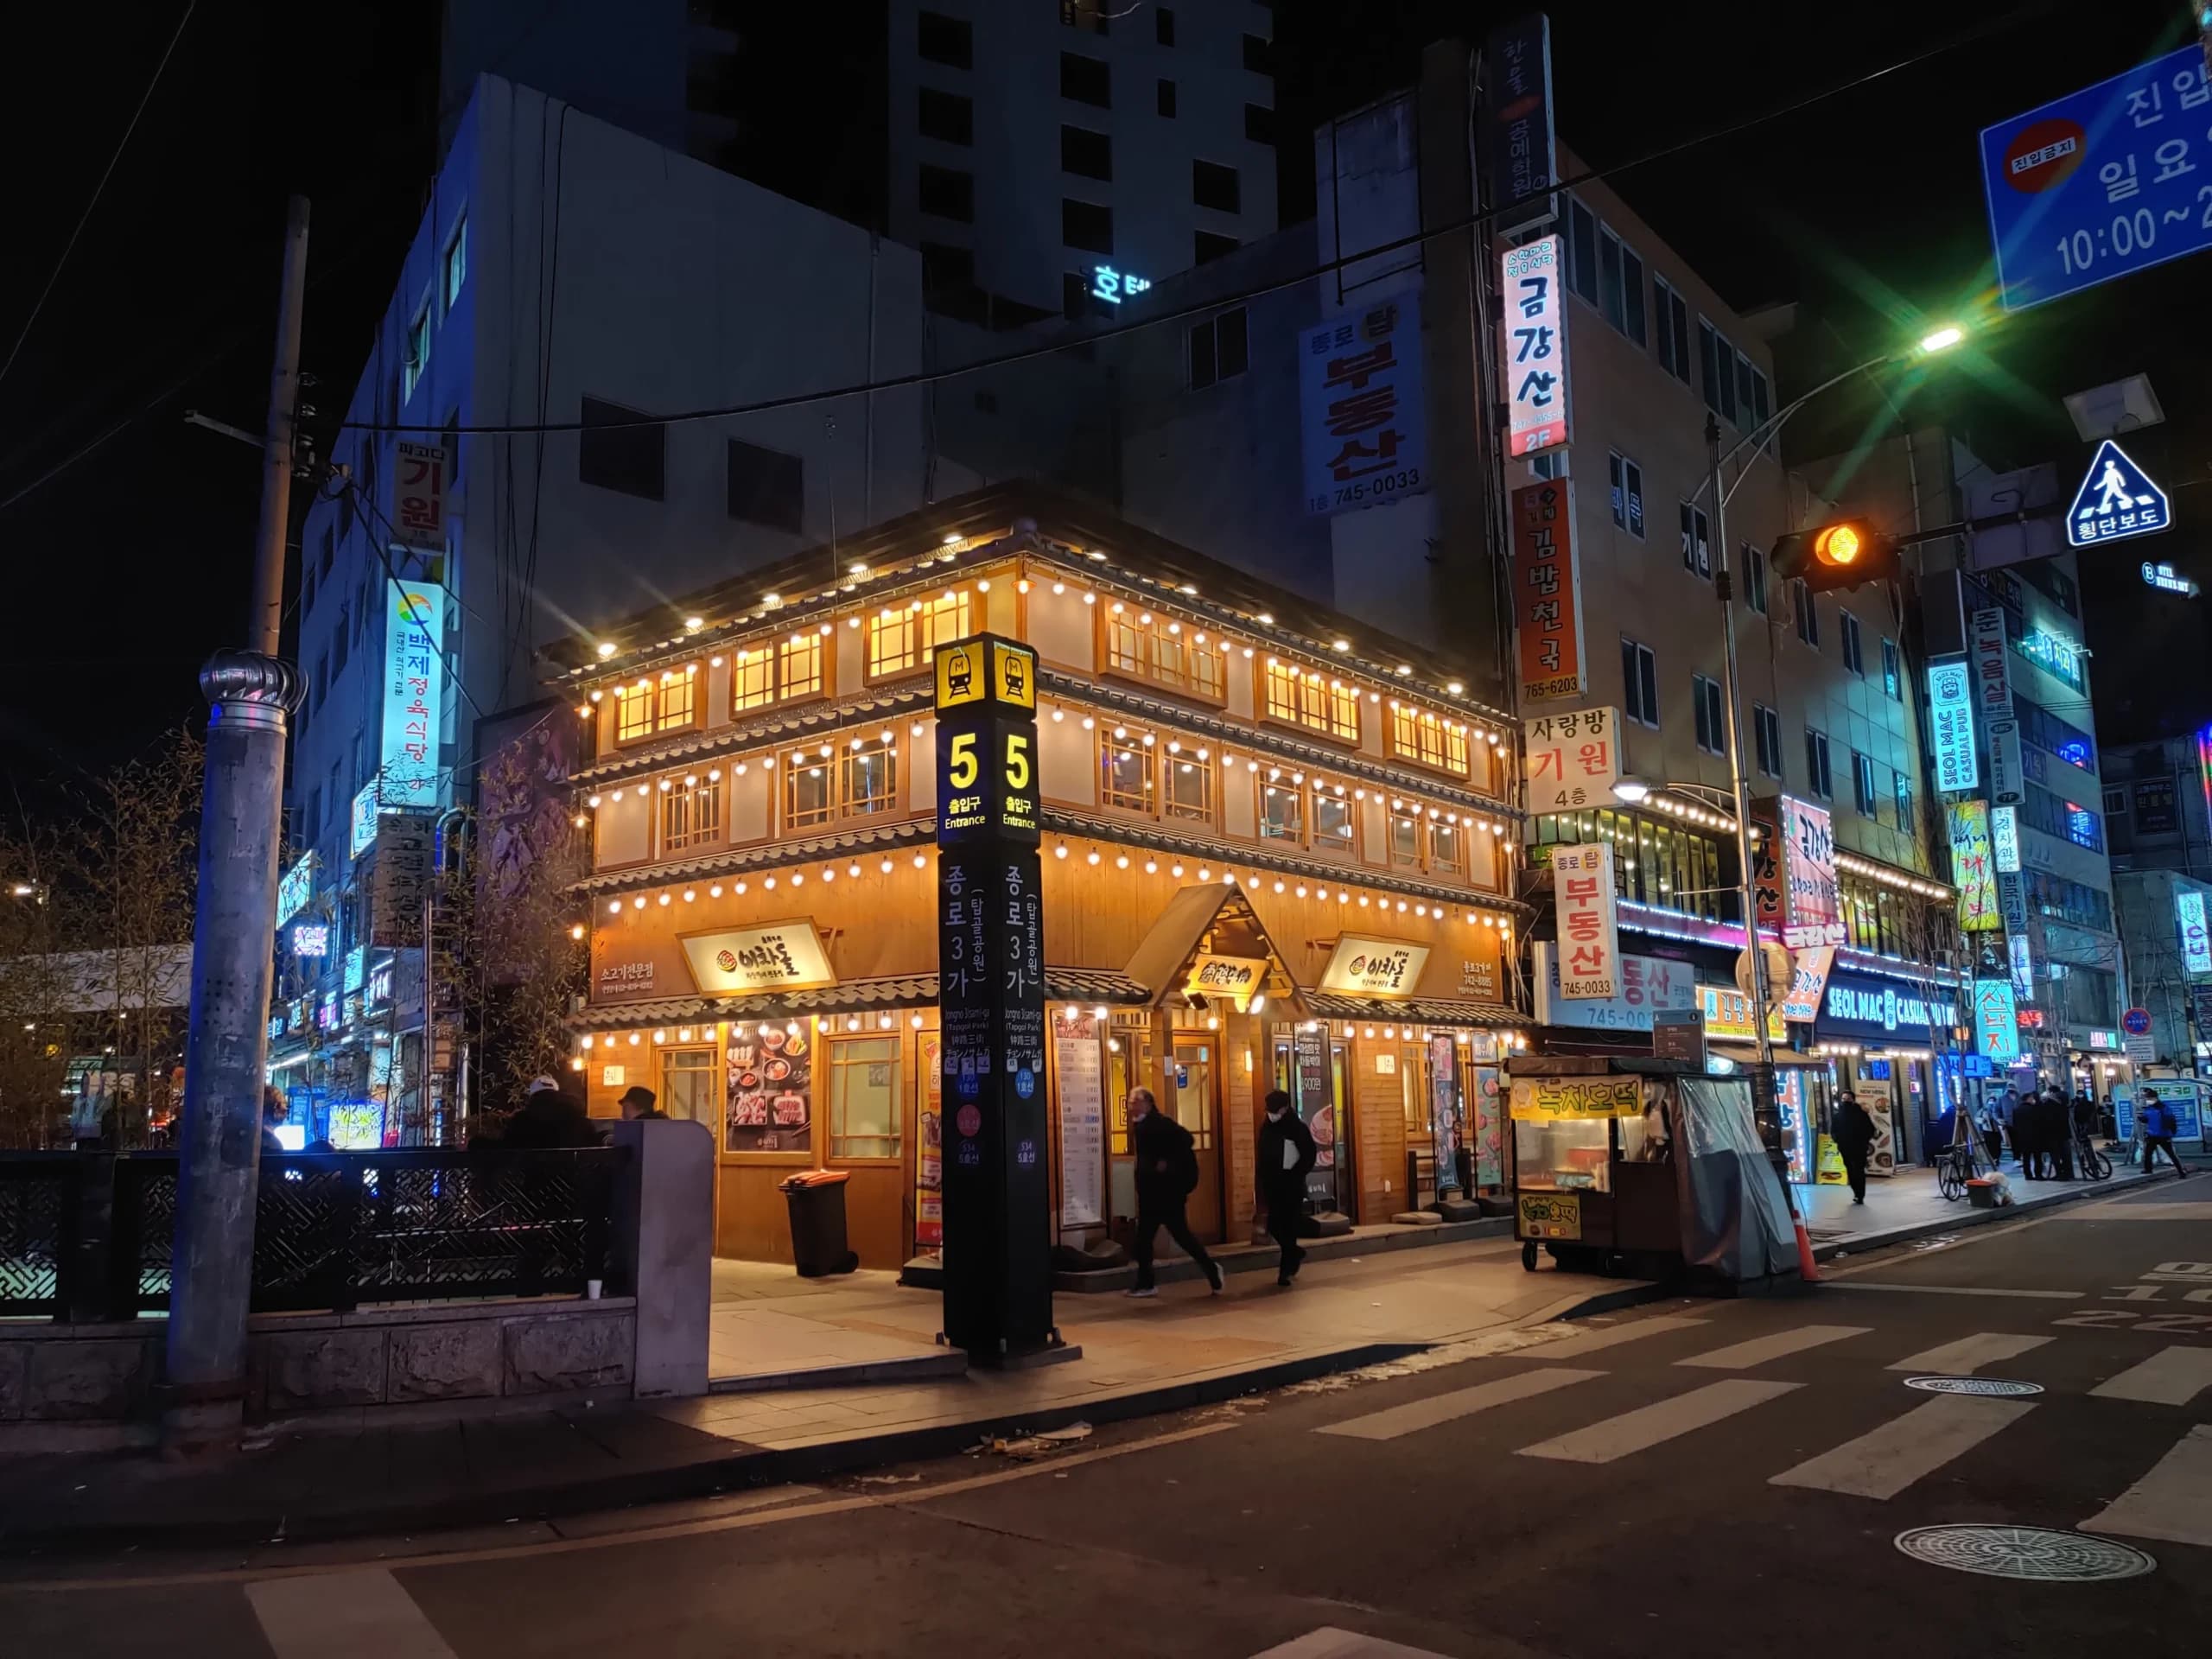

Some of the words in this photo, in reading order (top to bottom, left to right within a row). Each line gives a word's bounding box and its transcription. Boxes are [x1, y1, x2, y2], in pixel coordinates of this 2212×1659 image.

[2013, 140, 2074, 170] 진입금지
[2099, 127, 2212, 203] 일요
[1514, 276, 1556, 406] 금강산
[1323, 341, 1406, 481] 부동산
[1526, 429, 1550, 451] 2F
[401, 459, 442, 531] 기원
[1334, 468, 1420, 505] 745-0033
[2078, 509, 2159, 540] 횡단보도
[1528, 528, 1562, 672] 김밥천국
[1524, 677, 1578, 698] 765-6203
[1532, 710, 1605, 741] 사랑방
[1939, 710, 1955, 746] MAC
[1956, 708, 1967, 733] PUB
[950, 733, 978, 789] 5
[1006, 734, 1029, 789] 5
[1534, 741, 1608, 781] 기원
[1942, 749, 1958, 785] SEOL
[1959, 734, 1973, 783] CASUAL
[949, 797, 982, 814] 출입구
[1006, 797, 1033, 814] 출입구
[1555, 787, 1587, 806] 4층
[945, 815, 986, 830] Entrance
[1002, 814, 1036, 829] Entrance
[945, 865, 969, 998] 종로3가
[1006, 865, 1025, 998] 종로3가
[1565, 877, 1605, 976] 부동산
[601, 961, 653, 981] 소고기전문점
[739, 944, 799, 976] 이차돌
[1367, 957, 1408, 988] 이차돌
[1564, 980, 1611, 995] 745-0033
[1587, 1008, 1652, 1027] 745-00
[1829, 988, 1857, 1019] SEOL
[1859, 993, 1884, 1022] MAC
[1982, 992, 2010, 1052] 산낙지
[1538, 1080, 1638, 1115] 녹차호떡
[1522, 1199, 1577, 1224] 녹차호떡
